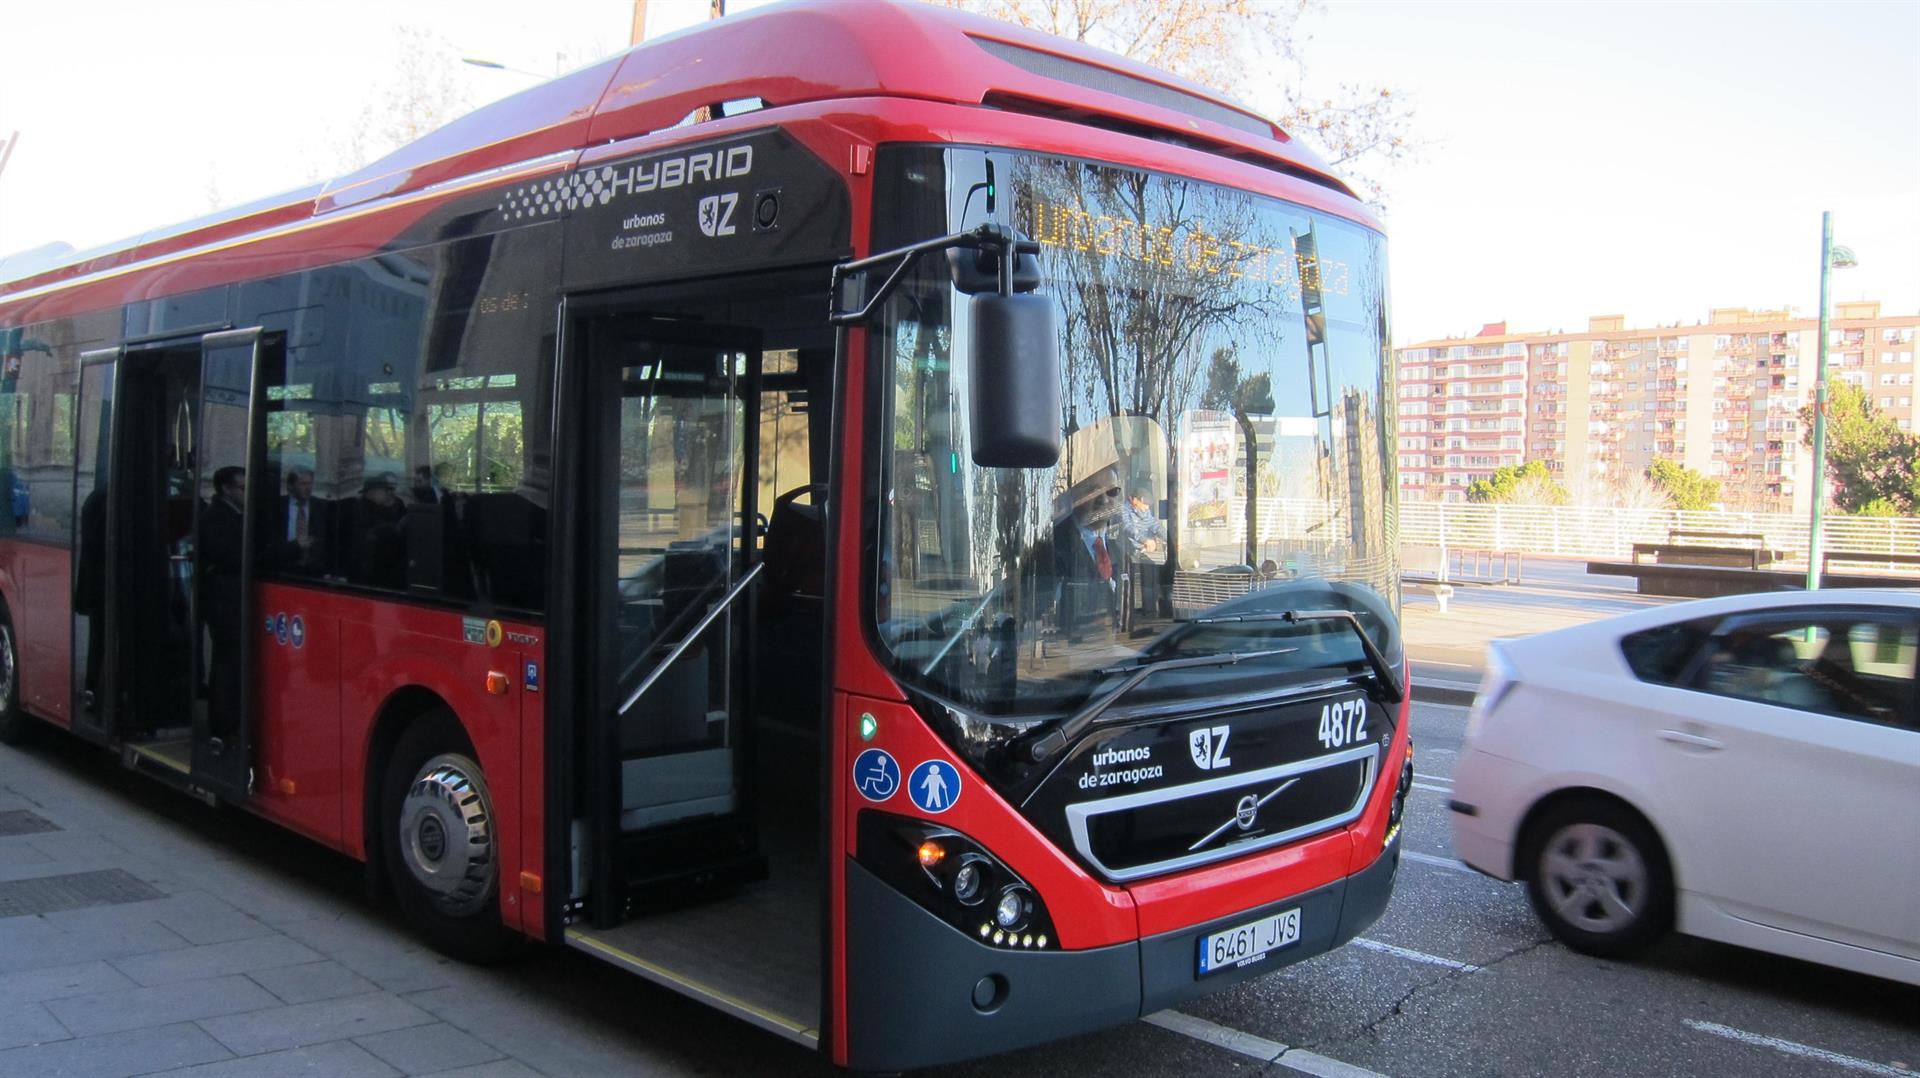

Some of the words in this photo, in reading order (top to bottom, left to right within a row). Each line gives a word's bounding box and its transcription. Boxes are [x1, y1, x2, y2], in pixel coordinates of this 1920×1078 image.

[611, 145, 753, 198] HYBRID
[623, 213, 665, 230] urbanos
[611, 235, 625, 250] de
[625, 231, 673, 247] zaragoza
[1318, 698, 1368, 749] 4872
[1092, 745, 1150, 768] urbanos
[1078, 772, 1097, 789] de
[1099, 765, 1163, 786] zaragoza
[1214, 926, 1256, 964] 6461
[1267, 913, 1296, 946] JVS
